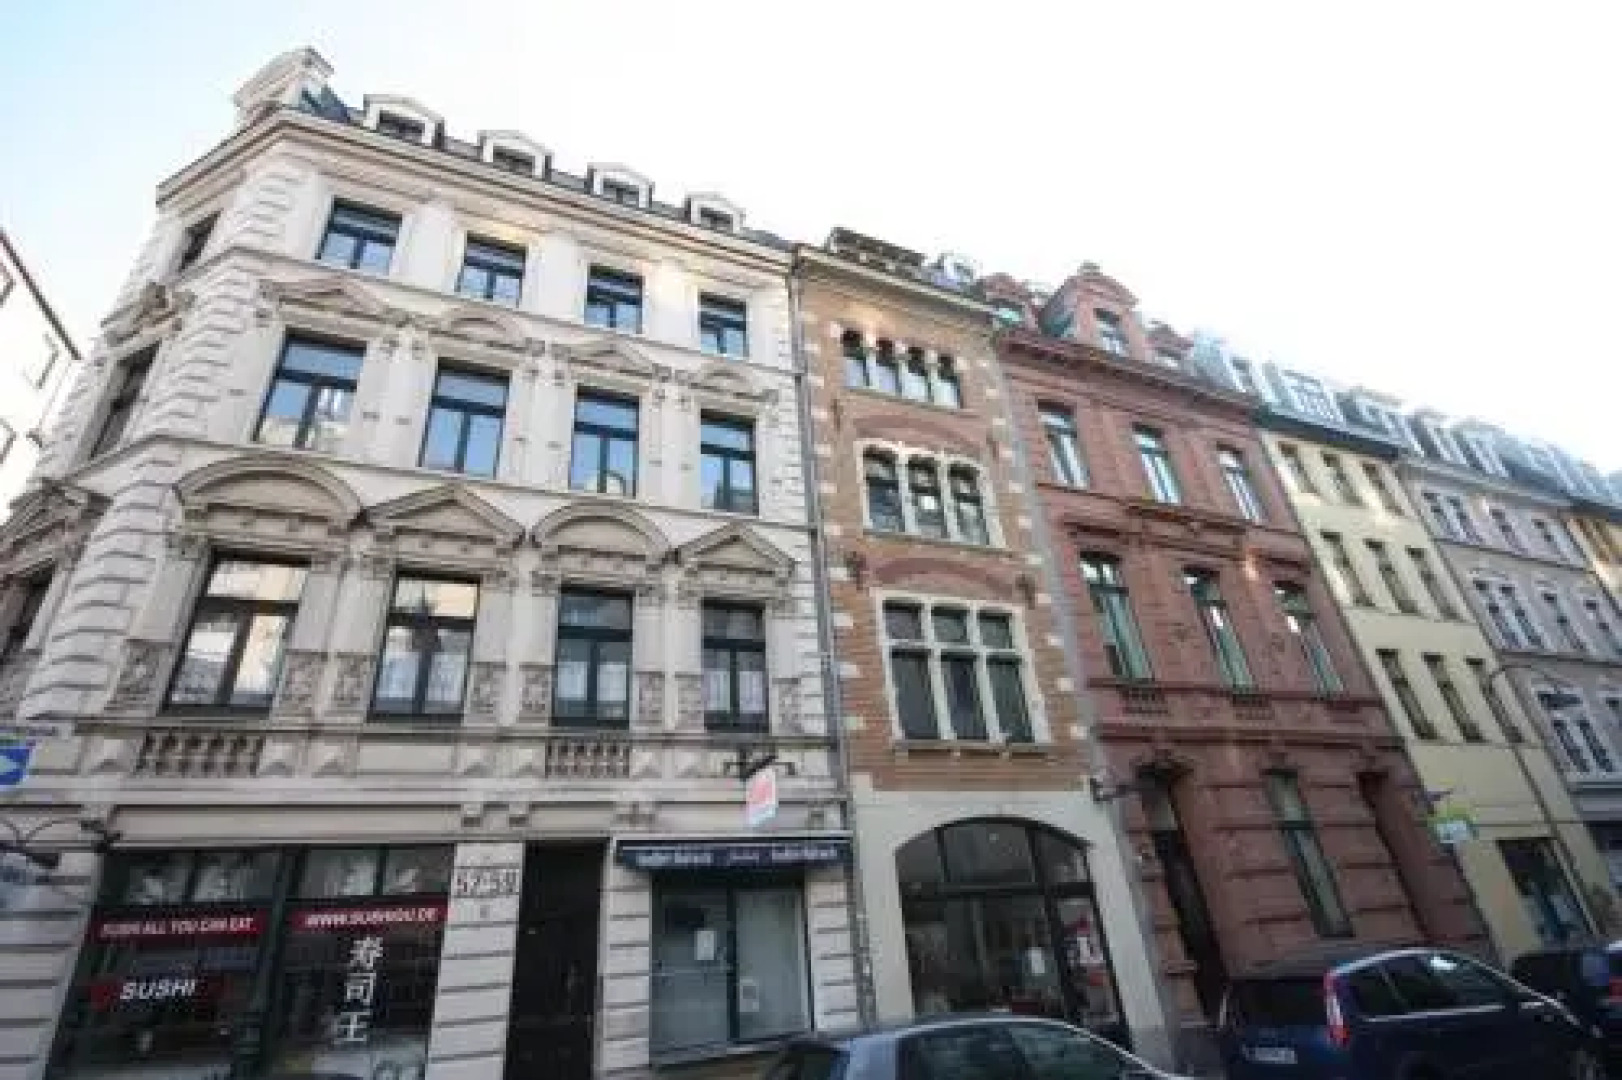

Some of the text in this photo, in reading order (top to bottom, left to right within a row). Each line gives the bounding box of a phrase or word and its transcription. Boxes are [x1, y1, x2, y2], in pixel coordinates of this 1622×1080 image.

[142, 921, 166, 935] ALL
[170, 919, 199, 935] YOU
[120, 979, 197, 1000] SUSHI
